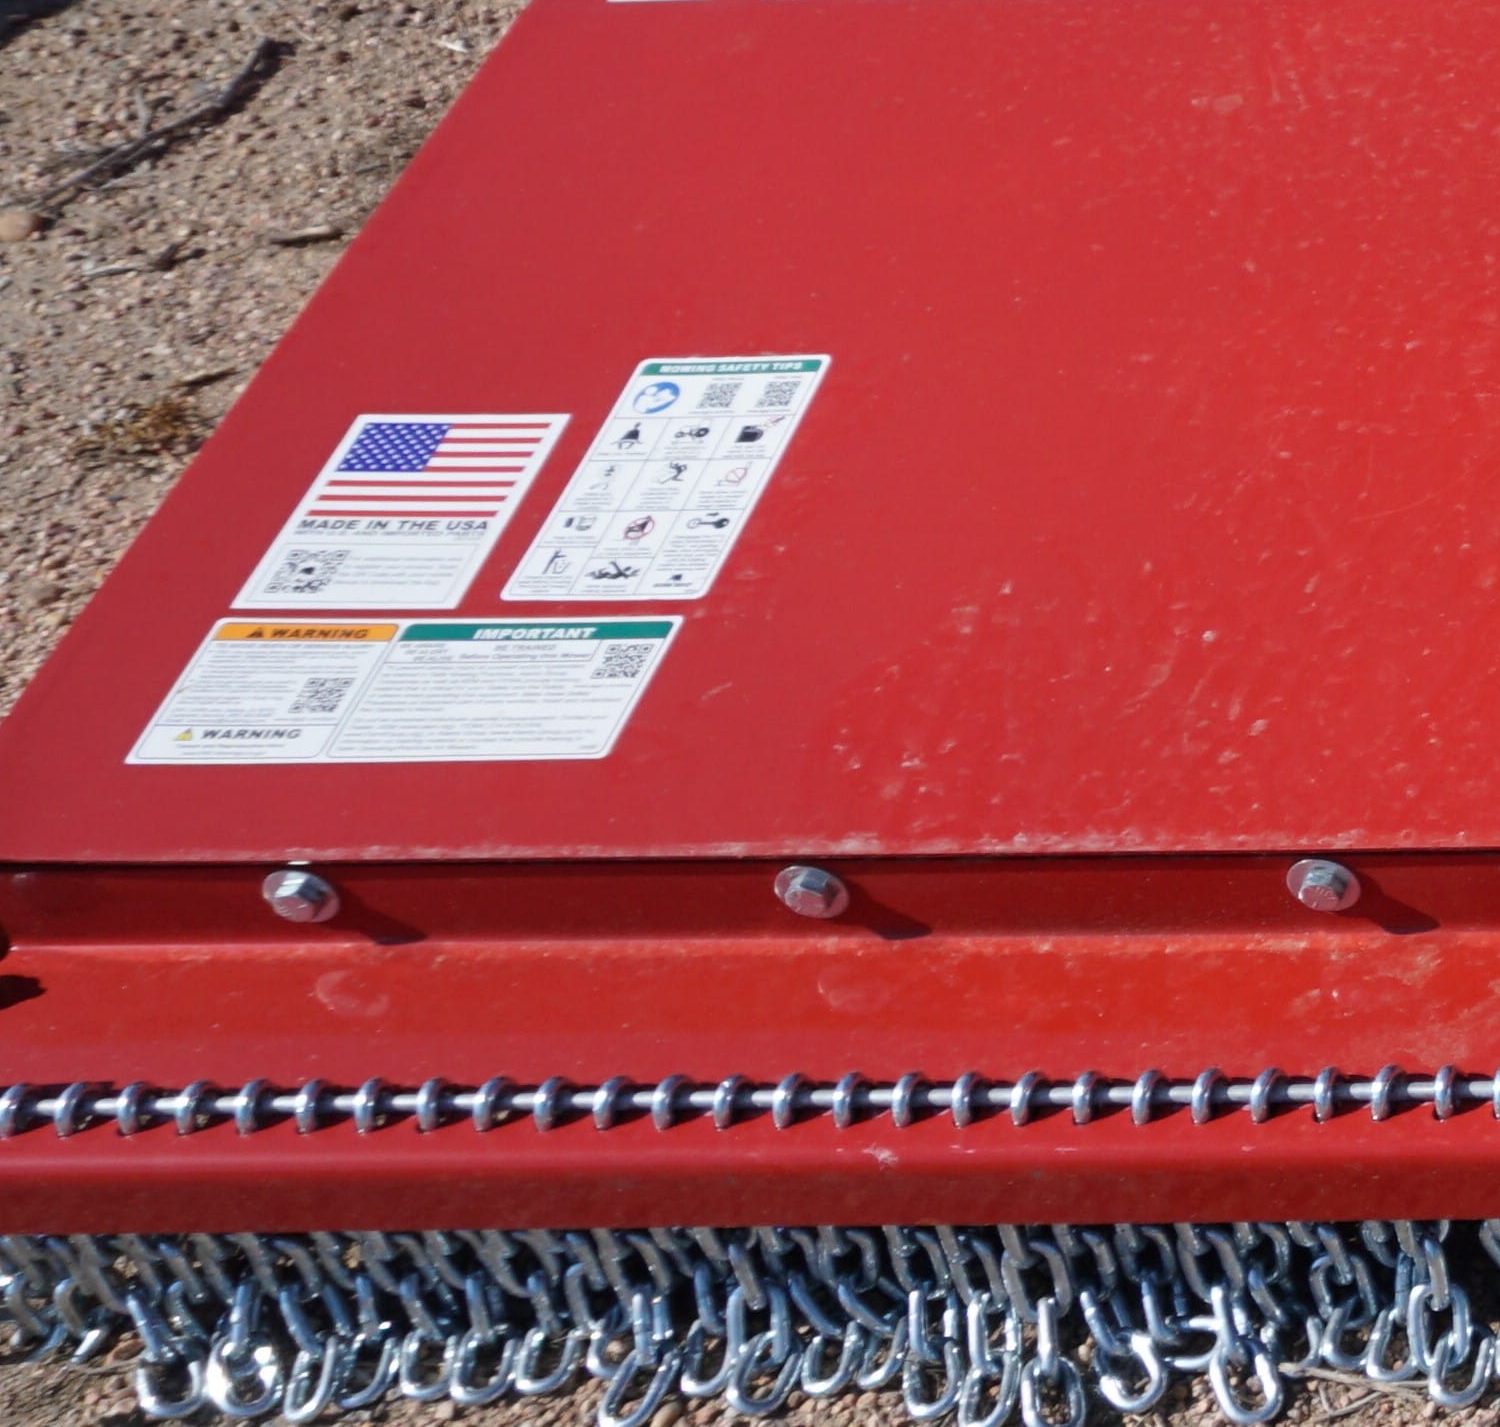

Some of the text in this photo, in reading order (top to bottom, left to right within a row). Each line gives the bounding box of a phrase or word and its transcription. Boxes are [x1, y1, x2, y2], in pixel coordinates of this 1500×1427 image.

[660, 362, 803, 374] MOWING SAFETY TIPS
[297, 518, 489, 531] MADE IN THE USA
[271, 628, 369, 640] WARNING
[473, 627, 596, 640] IMPORTANT
[202, 729, 303, 740] WARNING
